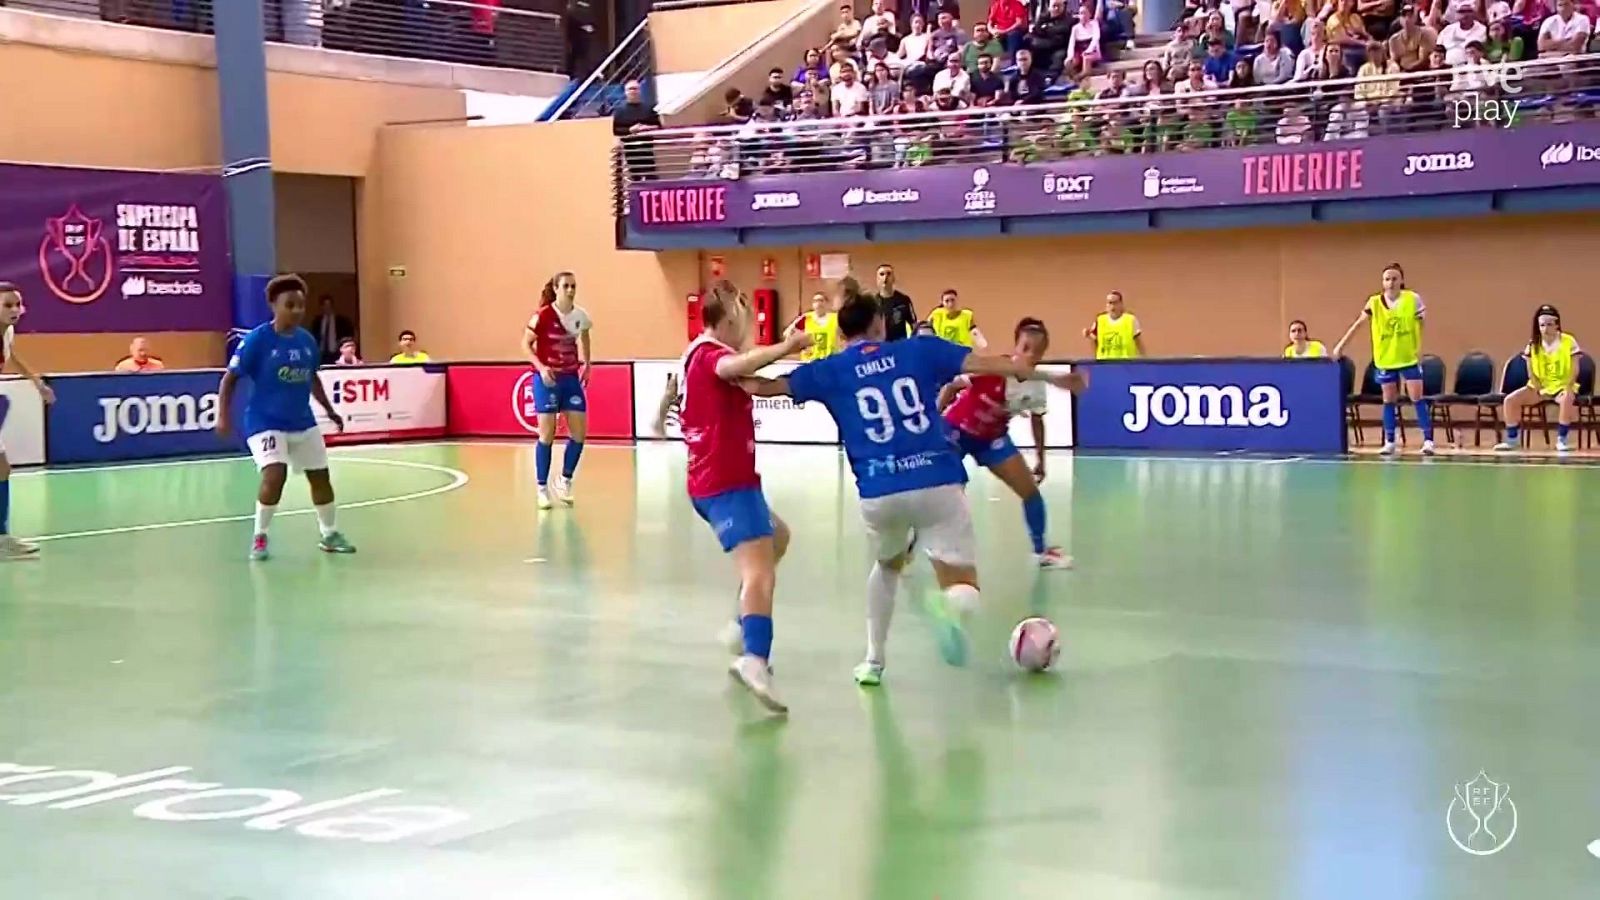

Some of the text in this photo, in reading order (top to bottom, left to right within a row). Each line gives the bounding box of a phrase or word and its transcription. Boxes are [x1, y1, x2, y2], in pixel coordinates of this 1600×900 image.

[1576, 145, 1600, 161] Ibe
[1056, 175, 1094, 192] DXT
[1243, 150, 1363, 194] TENERIFE
[639, 186, 725, 223] TENERIFE
[864, 187, 919, 204] Iberdrola
[116, 204, 198, 228] SUPERCOPA
[118, 227, 200, 252] DE ESPAÑA
[93, 393, 220, 442] Joma
[855, 376, 930, 444] 99
[1123, 384, 1289, 433] Joma
[261, 436, 276, 452] 20
[0, 763, 470, 843] drola
